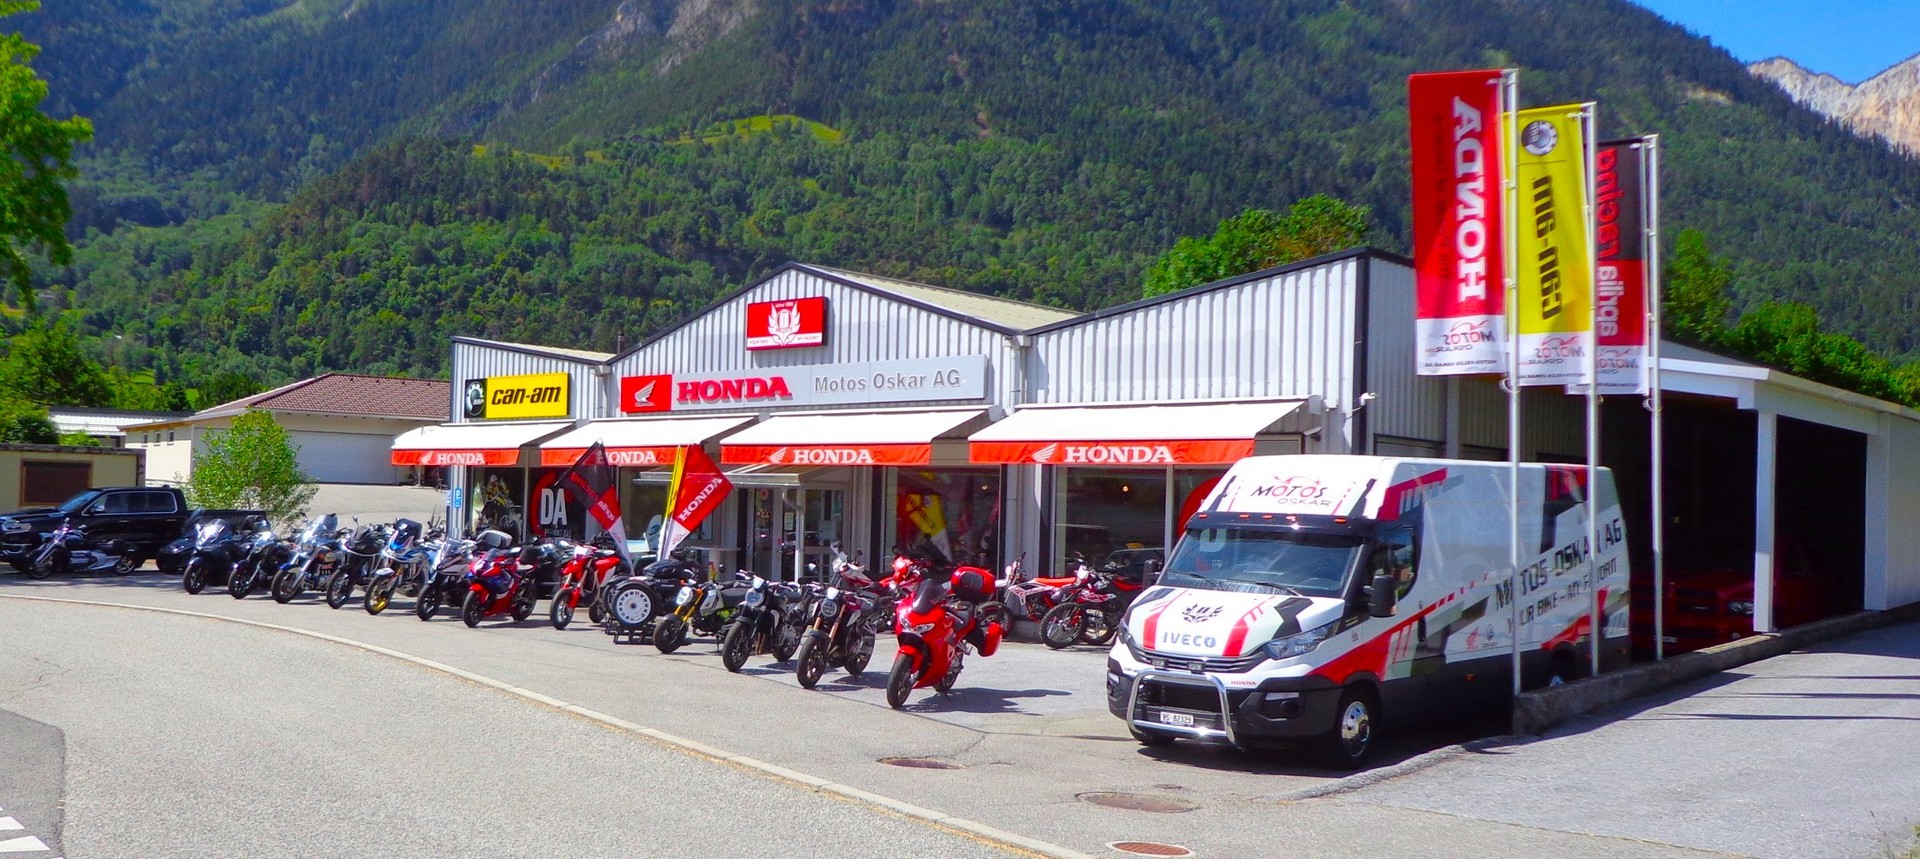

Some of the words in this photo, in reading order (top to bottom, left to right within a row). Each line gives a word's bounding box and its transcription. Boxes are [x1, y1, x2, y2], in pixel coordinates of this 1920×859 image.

[676, 376, 792, 403] HONDA
[815, 376, 866, 392] Motos
[873, 372, 926, 389] Oskar
[933, 369, 960, 387] AG
[491, 386, 561, 405] can-am
[437, 453, 486, 464] HONDA
[793, 449, 873, 464] HONDA
[1064, 446, 1174, 463] HONDA
[678, 477, 722, 522] HONDA
[1250, 485, 1328, 498] MOTOS
[1277, 498, 1331, 506] OSKAR
[1495, 558, 1548, 612] MTOS
[1605, 517, 1622, 549] AG
[1507, 605, 1534, 634] YUR
[1162, 632, 1216, 648] IVECO
